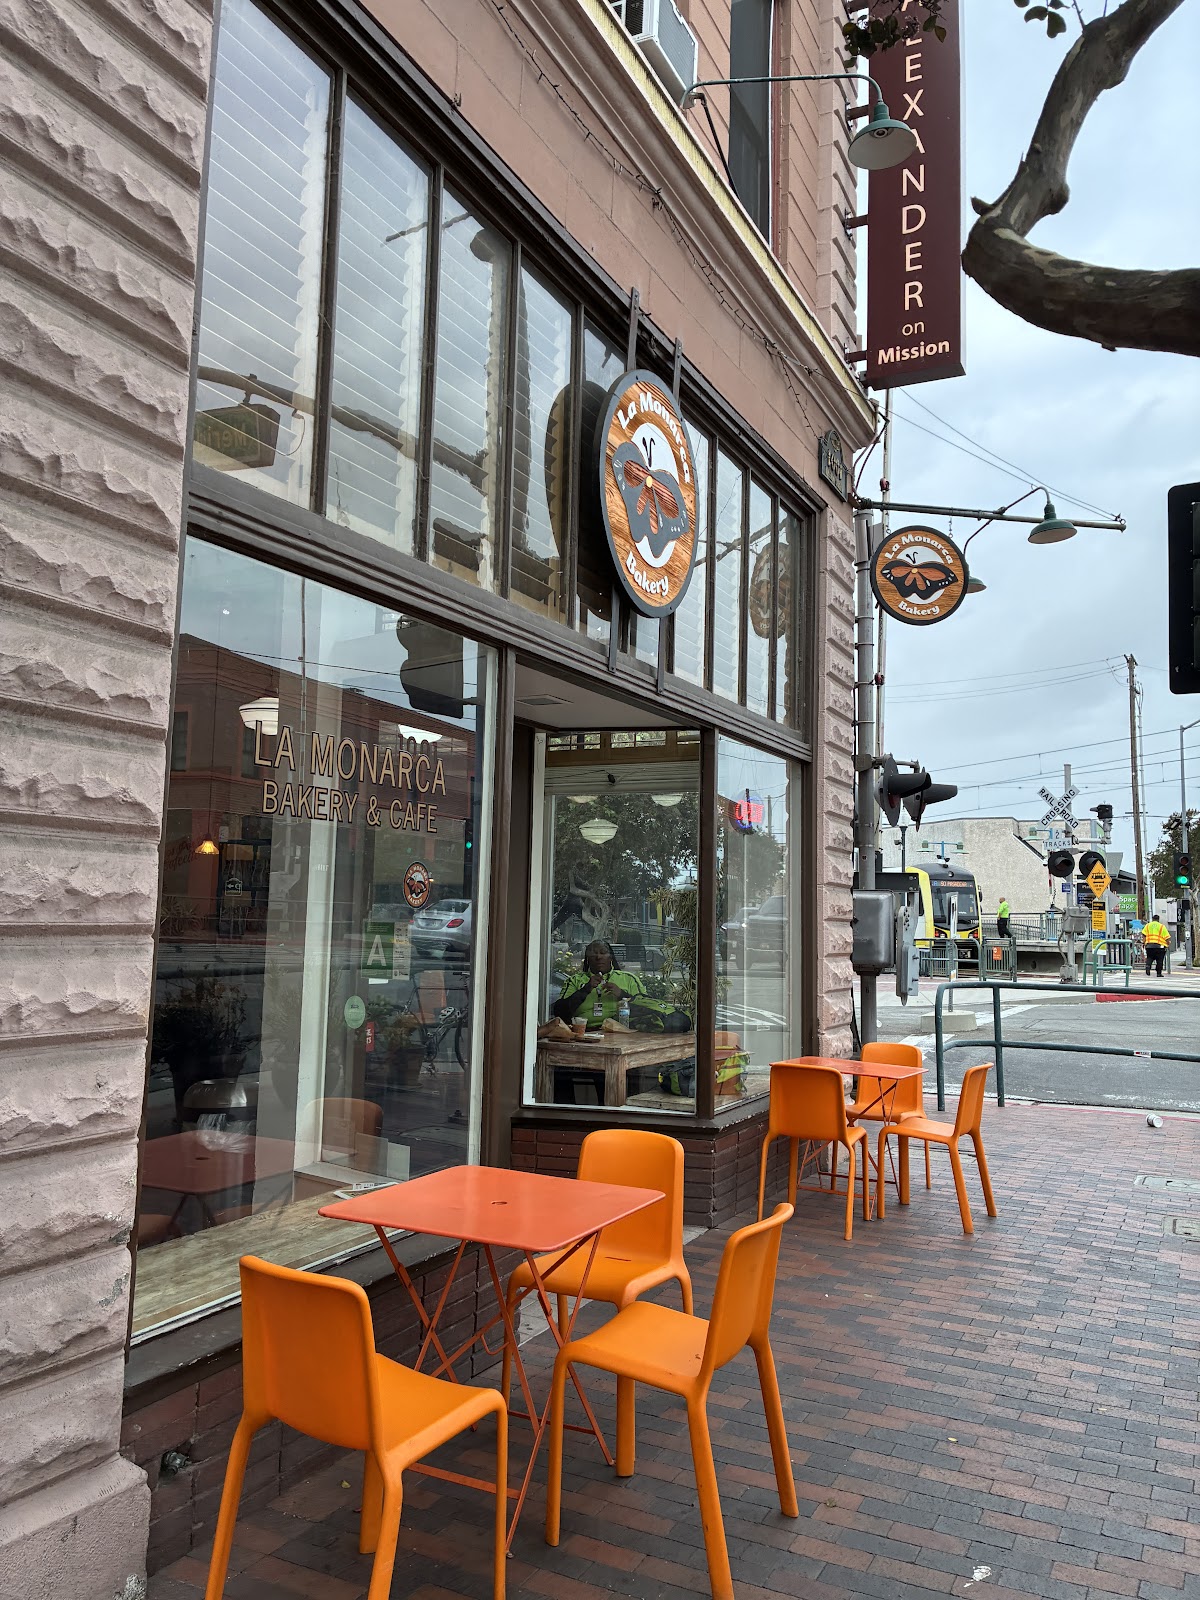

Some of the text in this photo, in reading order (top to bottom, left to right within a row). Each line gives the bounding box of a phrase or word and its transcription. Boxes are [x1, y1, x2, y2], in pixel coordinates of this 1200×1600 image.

[901, 0, 927, 311] EXNDER
[902, 321, 925, 336] on
[877, 340, 951, 365] Mission
[617, 392, 690, 483] La Monarca
[884, 533, 953, 564] La Monarca
[626, 551, 669, 596] Bakery
[898, 601, 940, 615] Bakery
[254, 720, 447, 796] LA MONARCA
[262, 779, 438, 833] BAKERY & CAFE
[1039, 788, 1079, 829] RAIL ROAD
[1041, 789, 1076, 826] CROSSING
[1055, 830, 1060, 839] 2
[367, 935, 386, 966] A
